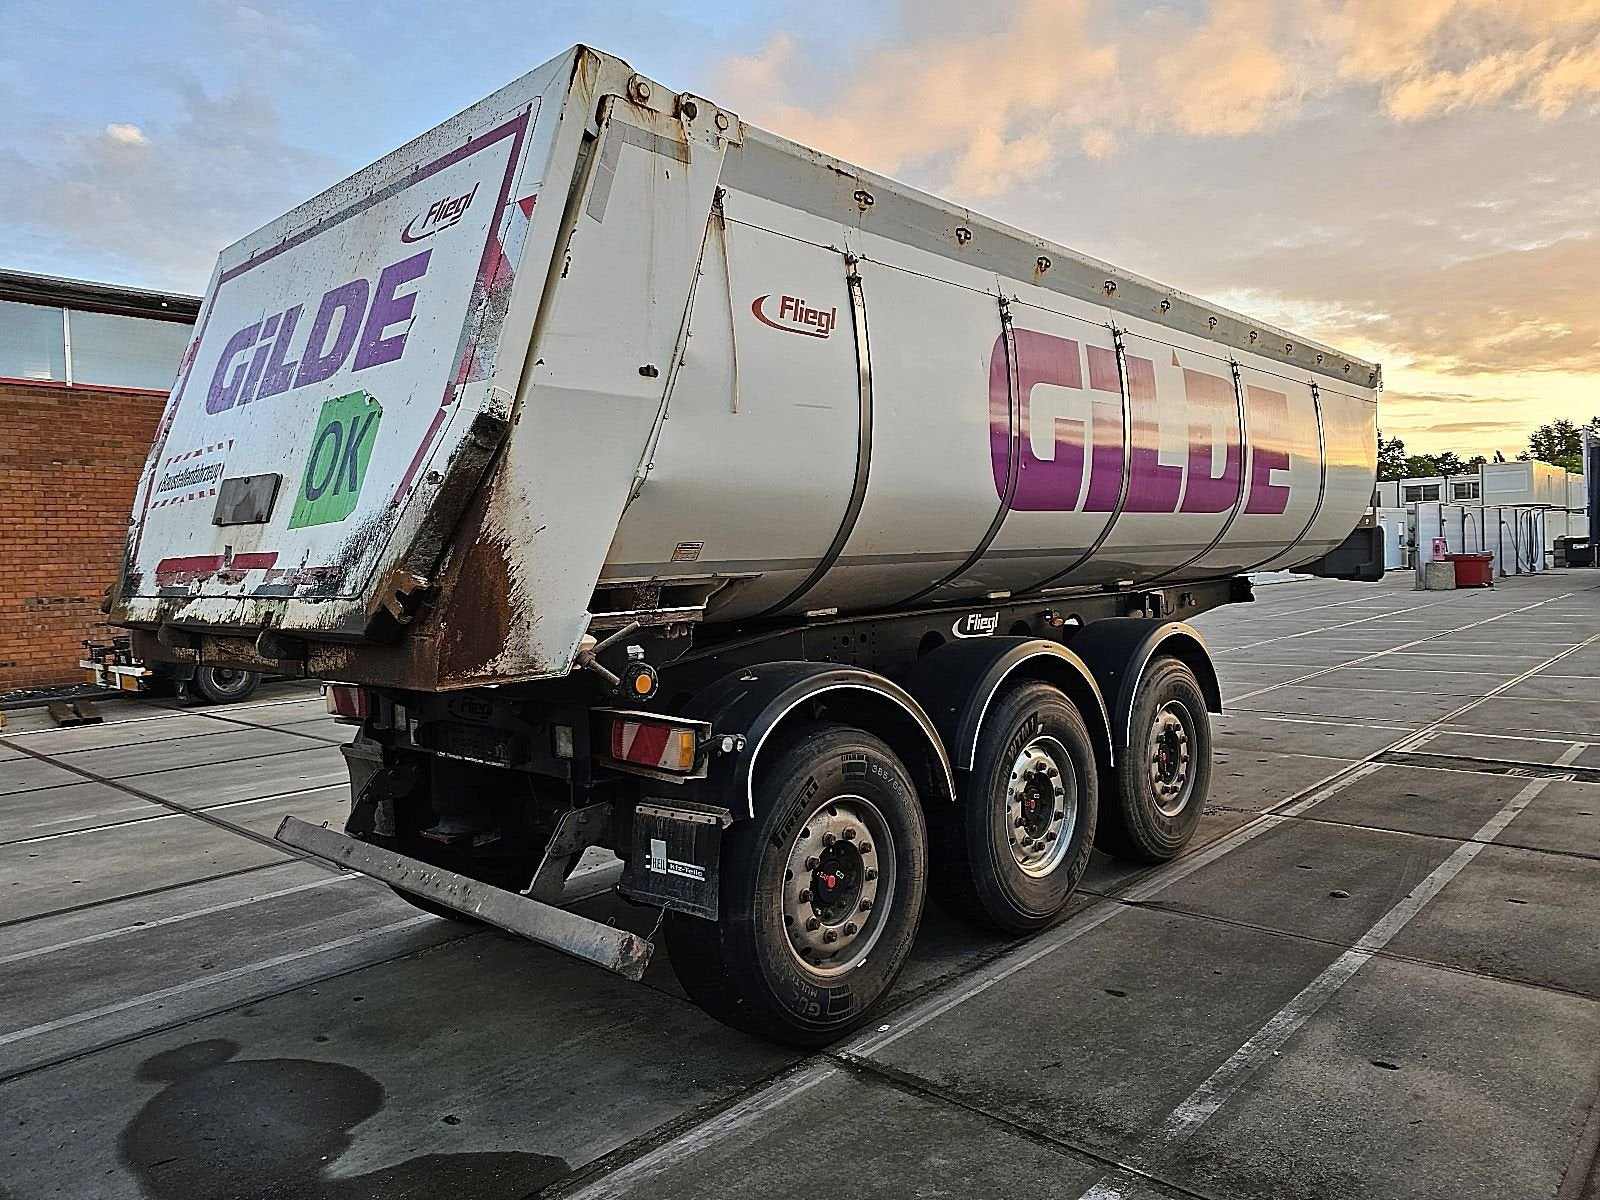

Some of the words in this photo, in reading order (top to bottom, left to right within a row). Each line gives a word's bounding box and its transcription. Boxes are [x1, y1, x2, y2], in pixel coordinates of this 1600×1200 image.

[421, 182, 480, 229] Fliegl
[780, 295, 836, 335] Fliegl
[305, 411, 377, 501] OK
[967, 611, 999, 632] Fliegl
[771, 775, 819, 850] PIRELLI
[652, 857, 665, 871] HEIL
